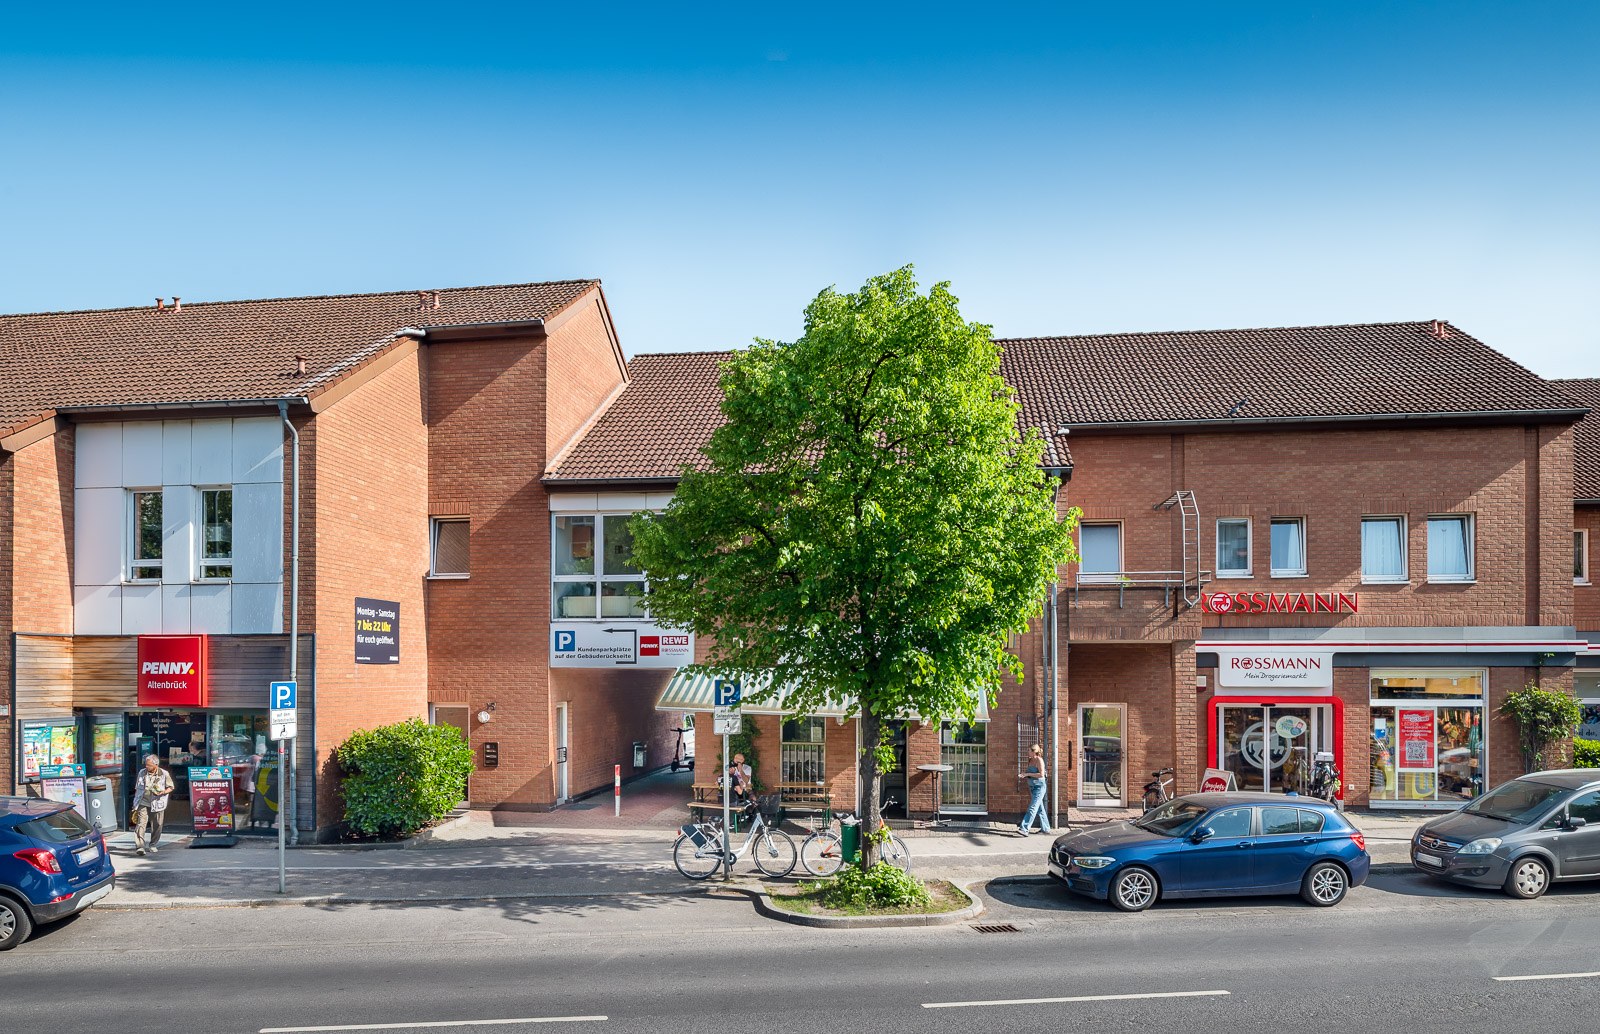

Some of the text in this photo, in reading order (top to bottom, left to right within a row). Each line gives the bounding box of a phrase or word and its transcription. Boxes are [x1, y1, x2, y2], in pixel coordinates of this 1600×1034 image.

[357, 606, 375, 617] Montag
[378, 609, 396, 620] Samstag
[357, 619, 392, 632] 7 bis 22 Uhr
[356, 634, 395, 646] für euch geöffnet.
[558, 632, 572, 650] P
[662, 636, 688, 645] REWE
[577, 646, 632, 654] Kundenparkplätze
[1231, 657, 1321, 669] ROSSMANN
[1259, 671, 1308, 682] Drogeriemarkt
[147, 680, 188, 689] Altenbrück
[276, 685, 291, 709] P
[720, 683, 735, 705] P
